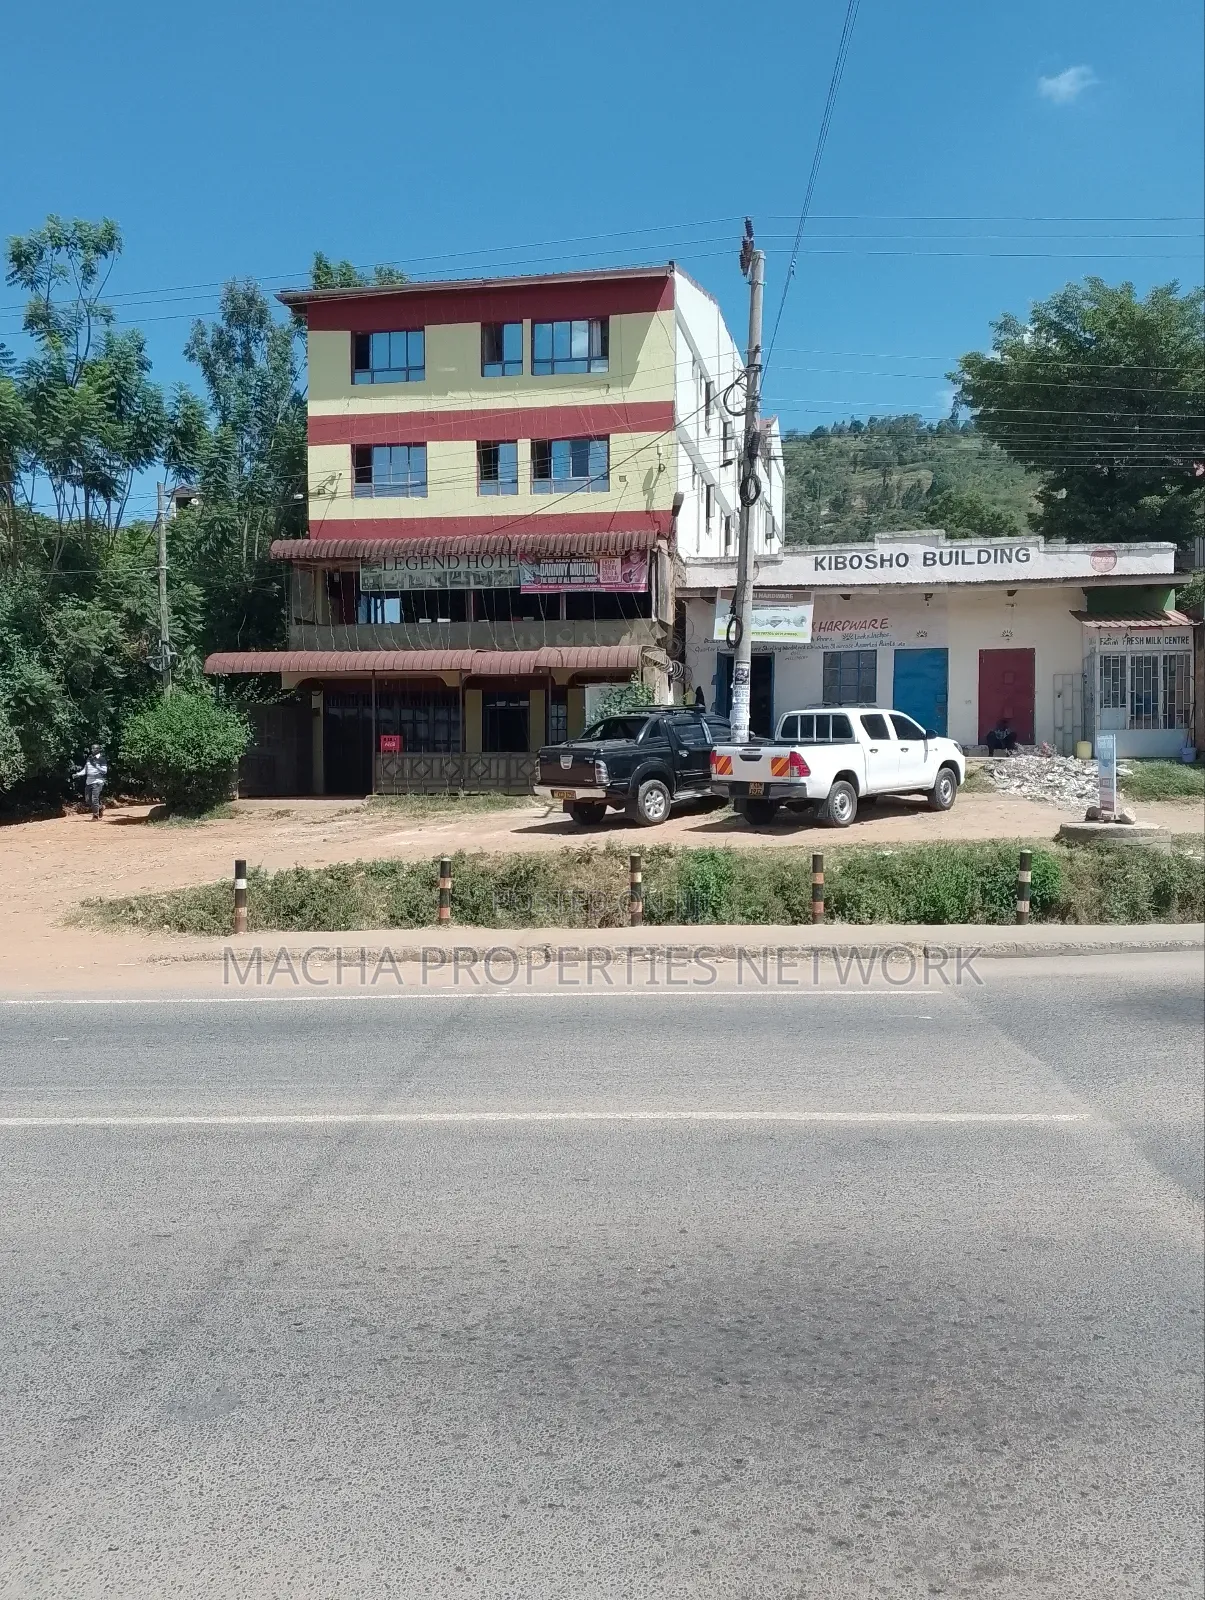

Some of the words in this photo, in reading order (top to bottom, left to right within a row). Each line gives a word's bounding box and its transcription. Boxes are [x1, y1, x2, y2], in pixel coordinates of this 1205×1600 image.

[382, 555, 460, 571] LEGEND
[467, 554, 519, 569] HOTE
[814, 552, 910, 571] KIBOSHO
[922, 547, 1031, 567] BUILDING
[570, 562, 598, 576] MUTUKU
[1122, 636, 1144, 646] FRESH
[1145, 636, 1162, 645] MILK
[1164, 636, 1190, 645] CENTRE
